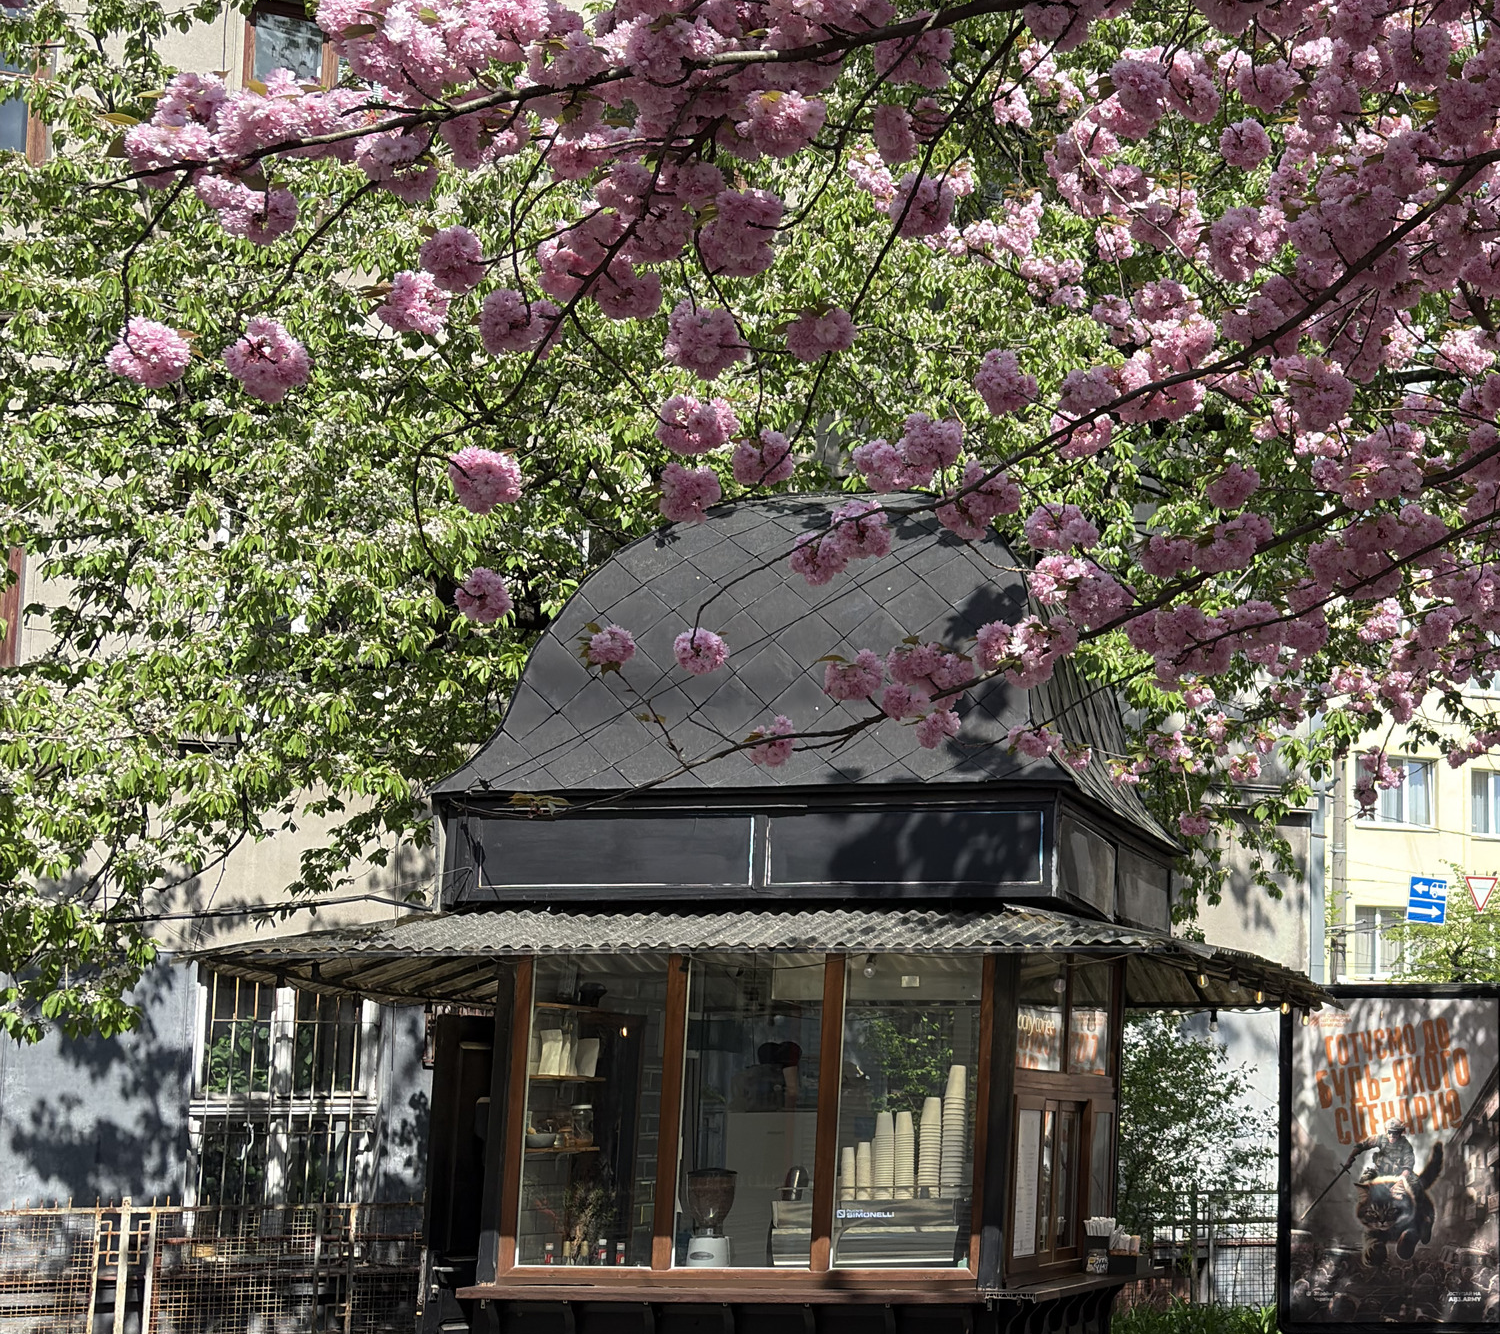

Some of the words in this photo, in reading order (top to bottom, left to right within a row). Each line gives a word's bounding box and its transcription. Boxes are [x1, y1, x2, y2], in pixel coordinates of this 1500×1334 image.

[1324, 1023, 1417, 1068] ГОТУЄМО
[1422, 1017, 1451, 1053] ДО
[1315, 1047, 1471, 1109] БУДЬ-ЯКОГО
[1334, 1089, 1463, 1145] СЦЕНАРІЮ
[846, 1211, 895, 1219] SIMONELLI
